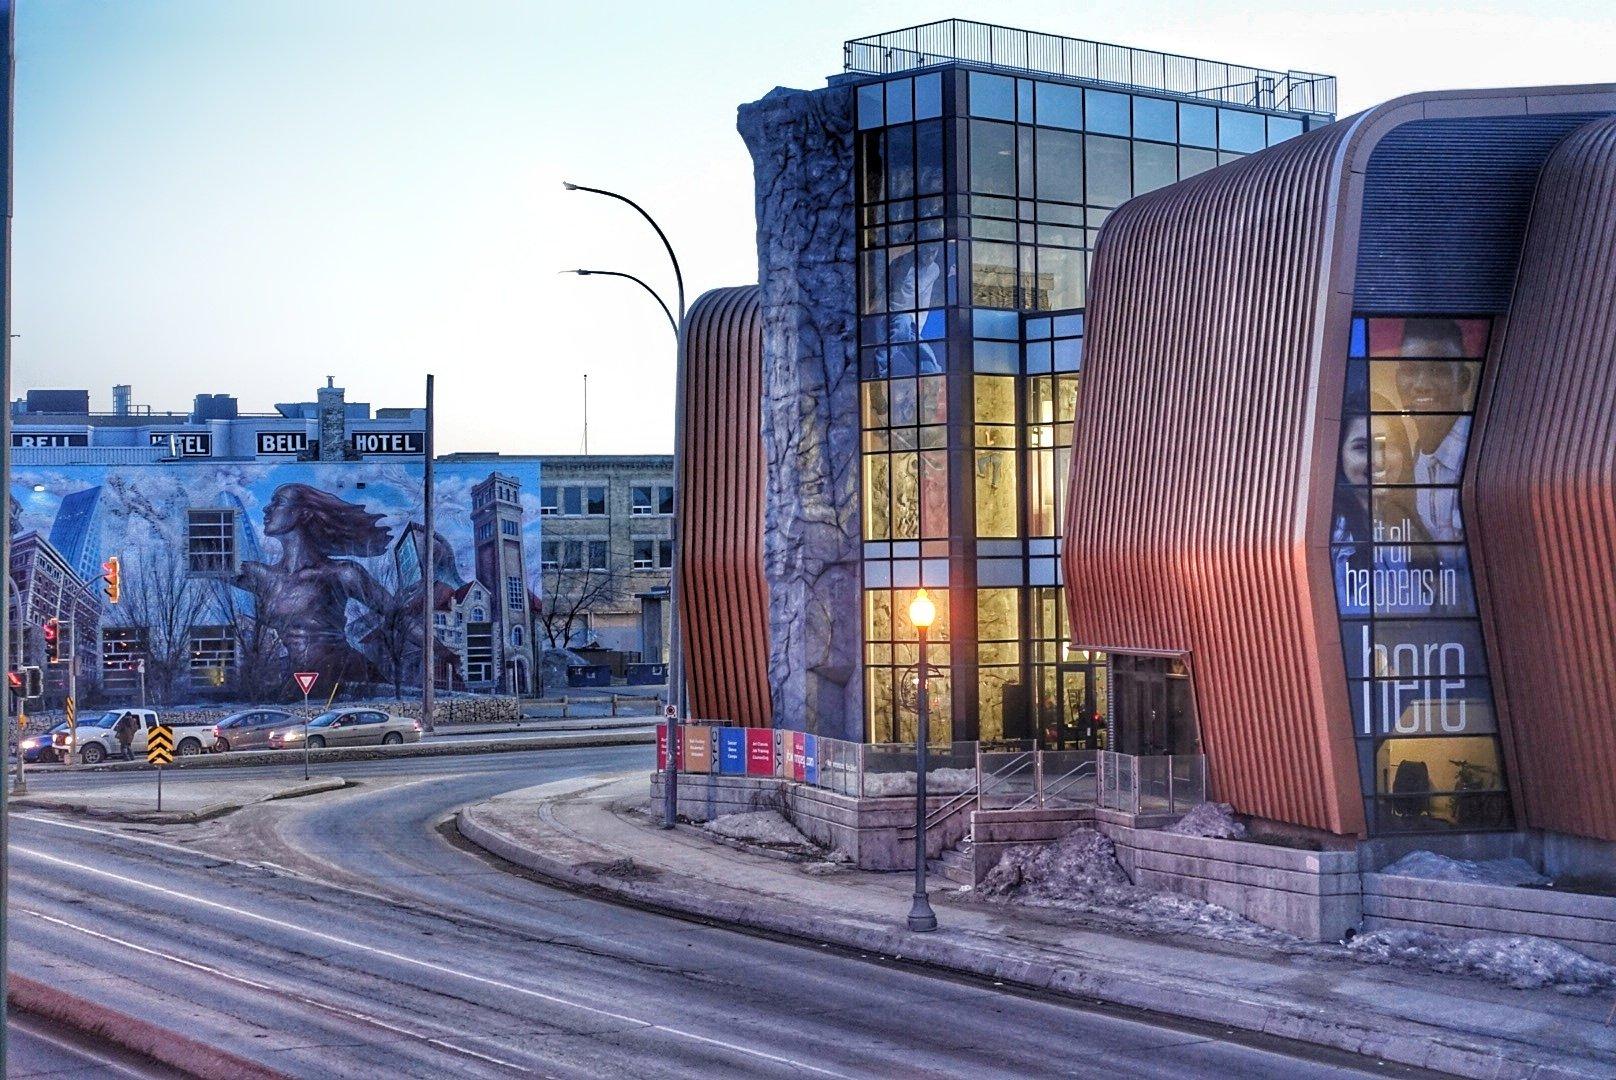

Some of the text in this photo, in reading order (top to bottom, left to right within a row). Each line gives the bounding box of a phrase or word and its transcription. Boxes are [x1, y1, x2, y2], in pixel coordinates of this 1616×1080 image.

[262, 434, 308, 451] BELL
[355, 434, 416, 451] HOTEL
[1373, 518, 1411, 563] it all
[1345, 561, 1456, 613] happens in
[1362, 625, 1466, 733] here
